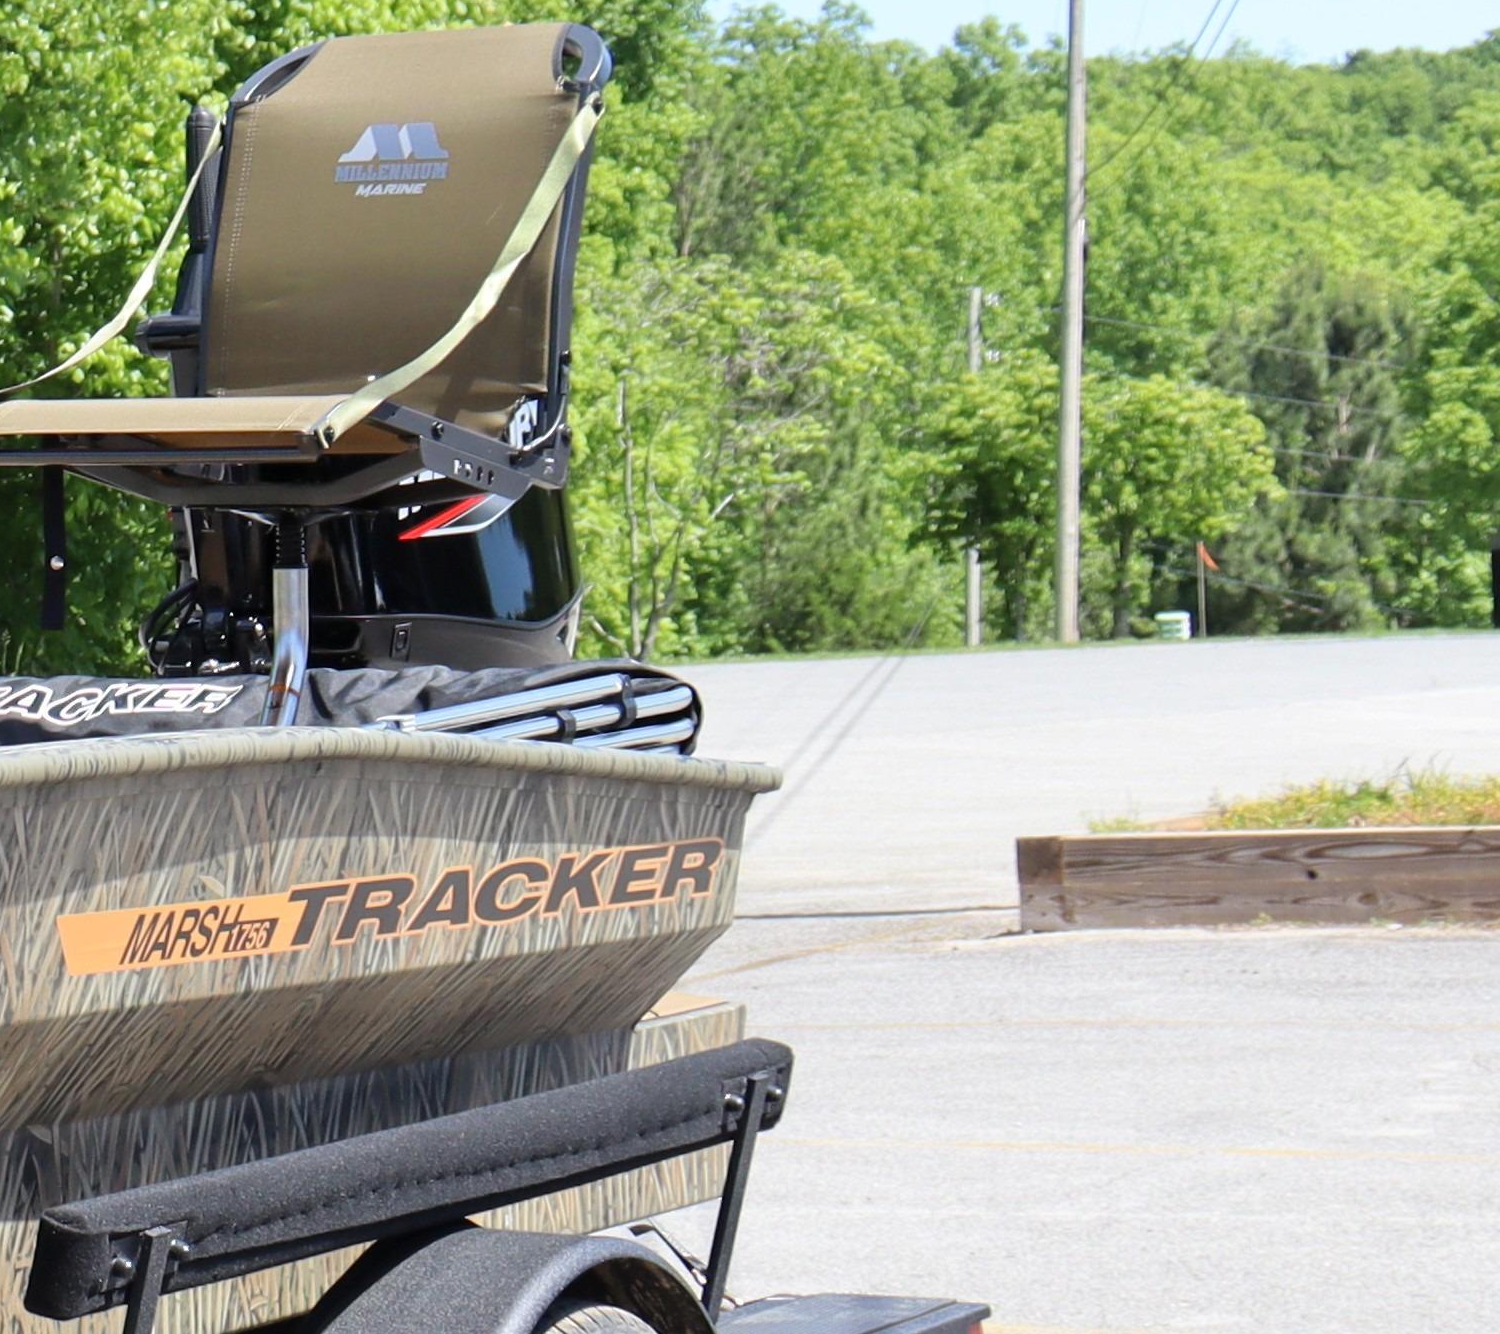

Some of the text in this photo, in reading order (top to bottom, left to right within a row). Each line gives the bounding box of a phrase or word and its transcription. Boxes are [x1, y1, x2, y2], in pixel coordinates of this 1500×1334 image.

[355, 183, 427, 197] MARINE
[119, 839, 724, 965] MARSH 1756 TRACKER
